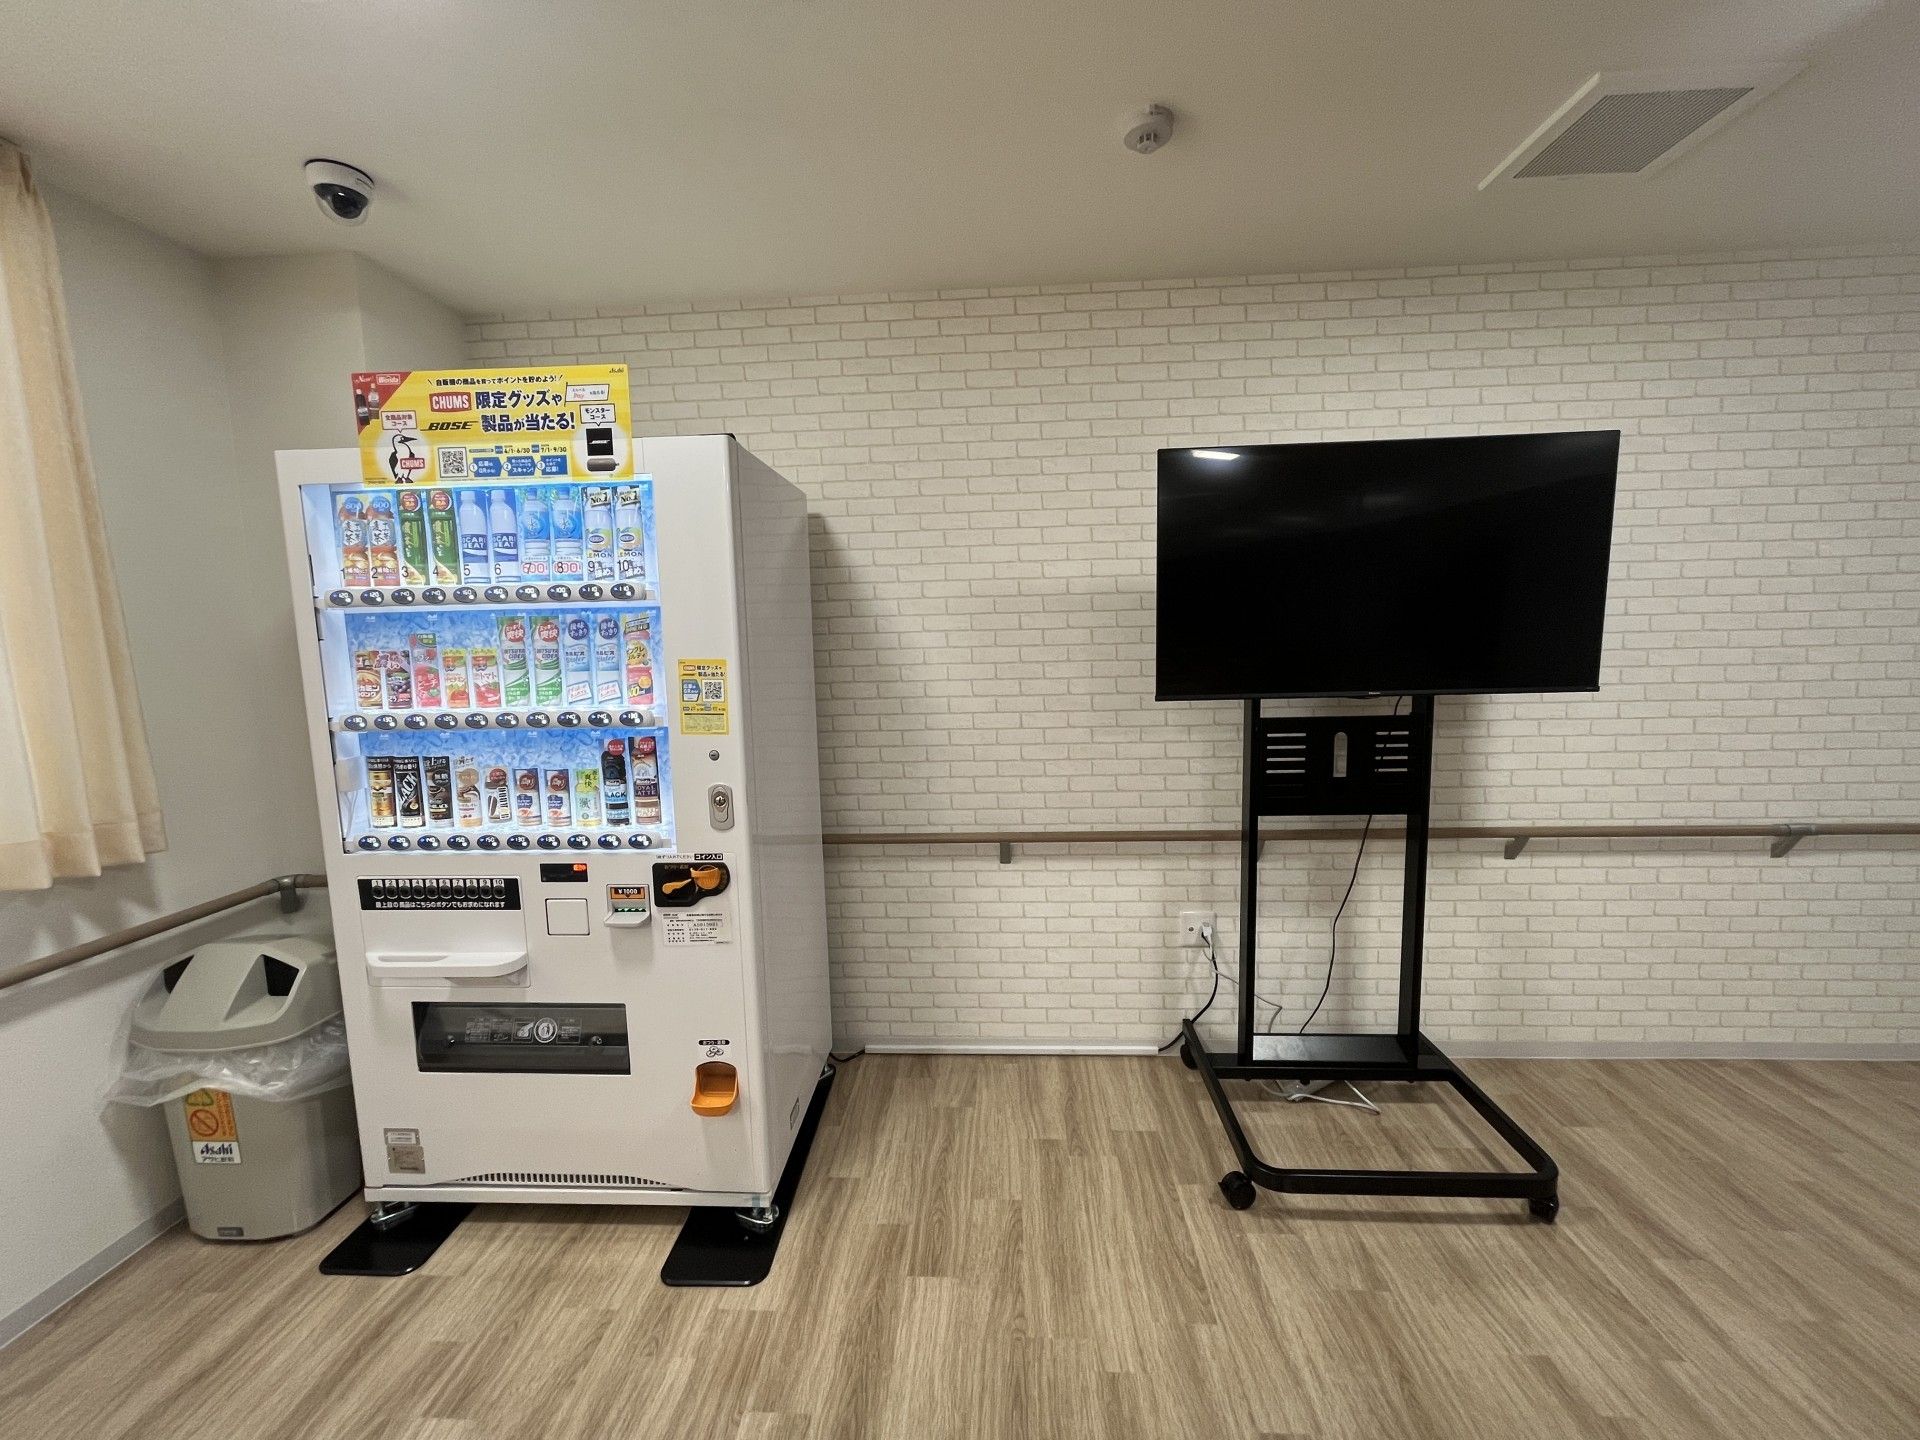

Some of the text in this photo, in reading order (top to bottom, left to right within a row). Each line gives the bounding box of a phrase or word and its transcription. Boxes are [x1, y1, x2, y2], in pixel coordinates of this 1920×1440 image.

[431, 394, 470, 411] CHUMS
[475, 389, 562, 410] 限定グッズや
[423, 421, 477, 431] BOSE
[481, 411, 576, 433] 製品が当たる!
[401, 459, 424, 468] CHUMS
[432, 565, 439, 576] 4
[464, 564, 471, 576] 5
[494, 563, 502, 575] 6
[587, 560, 595, 572] 9
[617, 559, 630, 572] 10
[340, 567, 346, 579] 1
[371, 566, 378, 579] 2
[401, 566, 409, 578] 3
[200, 1143, 233, 1155] Asahi
